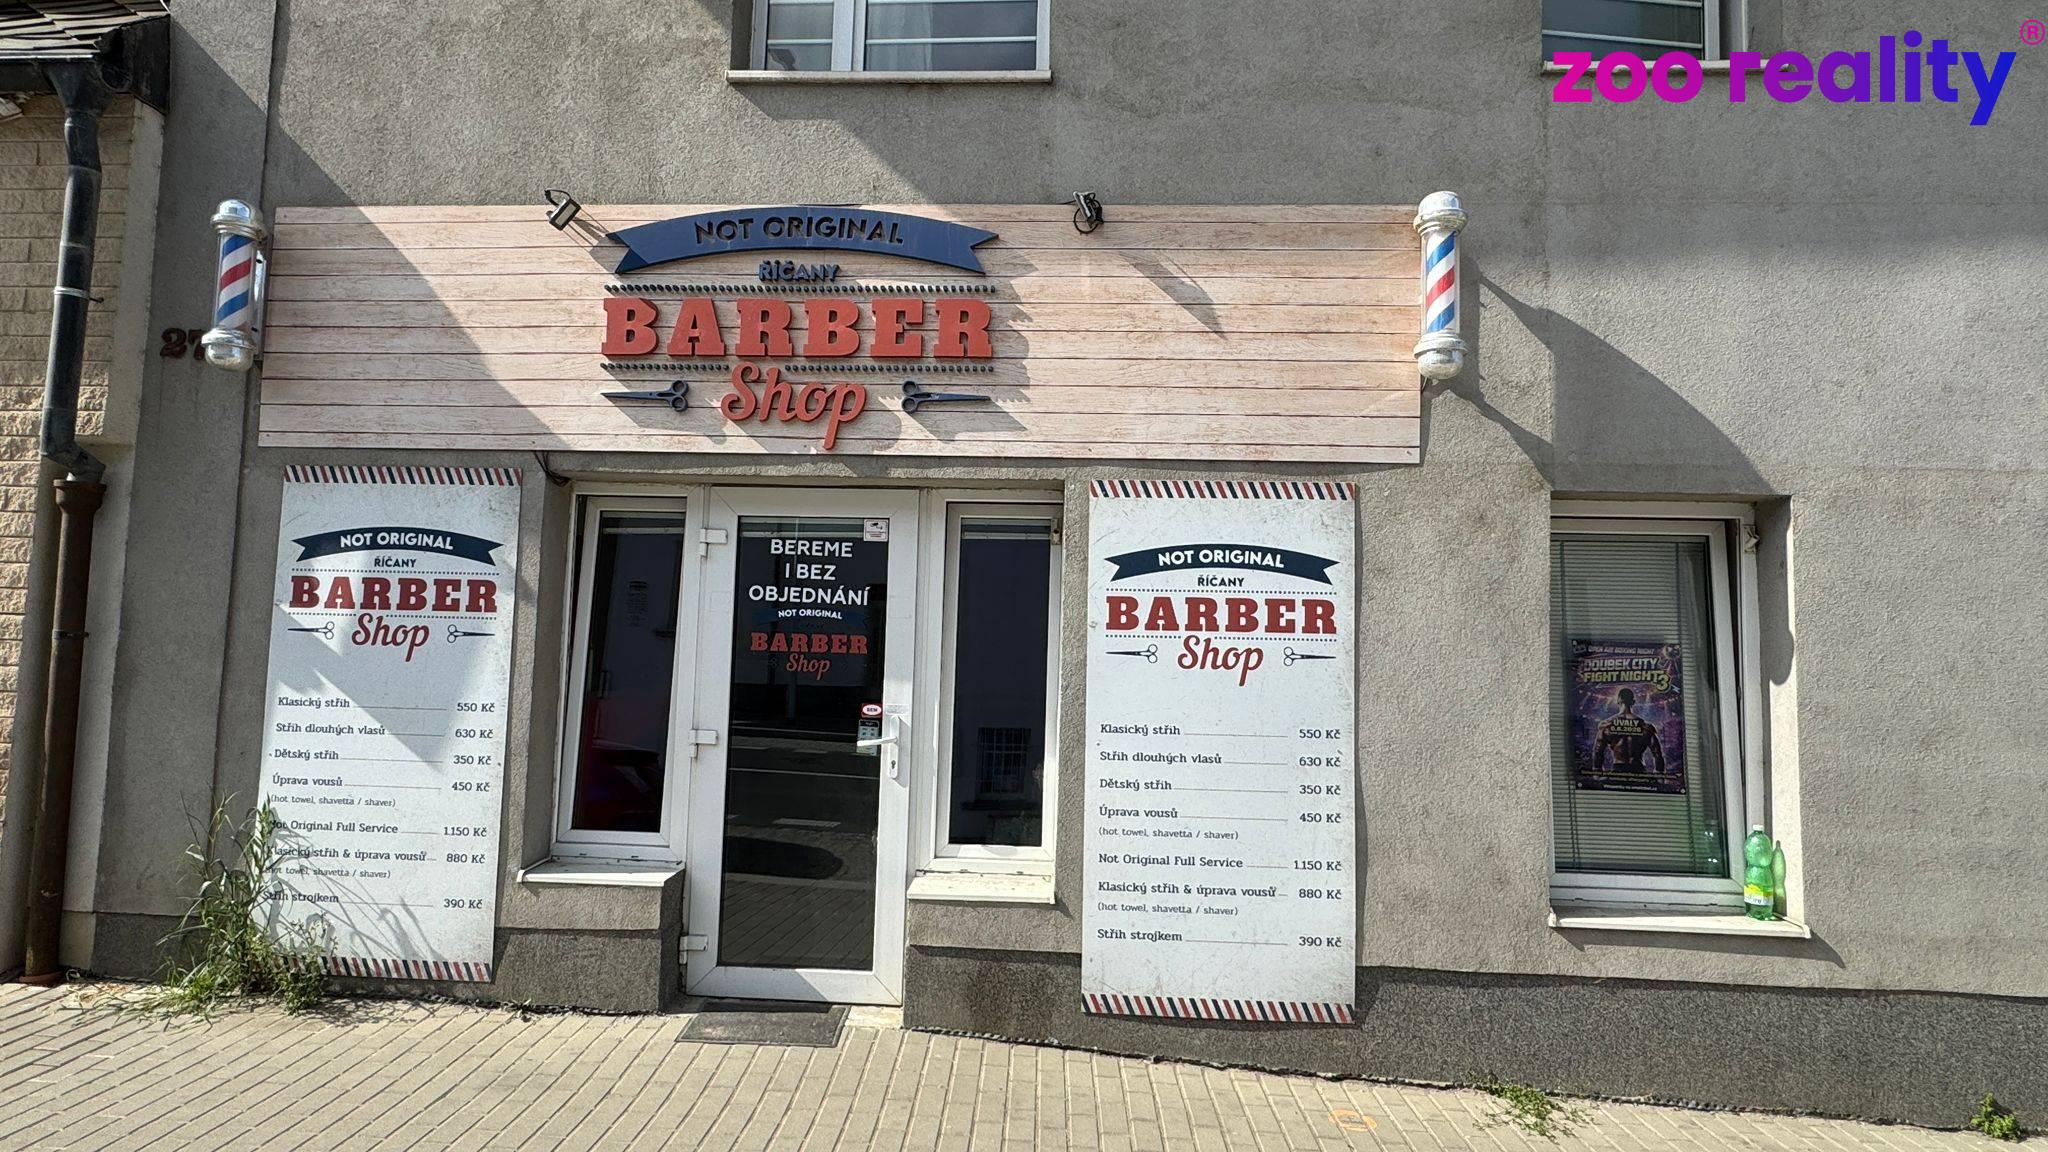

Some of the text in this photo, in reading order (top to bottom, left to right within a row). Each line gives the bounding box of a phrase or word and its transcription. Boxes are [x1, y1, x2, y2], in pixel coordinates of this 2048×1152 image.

[694, 216, 903, 245] NOT ORIGINAL
[758, 259, 840, 282] ŘÍČANY
[601, 297, 993, 358] BARBER
[721, 361, 866, 450] Shop
[340, 532, 454, 550] NOT ORIGINAL
[770, 538, 853, 558] BEREME
[374, 555, 416, 568] ŘÍČANY
[1158, 549, 1285, 568] NOT ORIGINAL
[785, 563, 836, 581] I BEZ
[1197, 574, 1244, 587] ŘÍČANY
[289, 575, 498, 613] BARBER
[749, 585, 871, 606] OBJEDNÁNÍ
[778, 608, 842, 619] NOT ORIGINAL
[1105, 595, 1337, 634] BARBER
[352, 612, 430, 662] Shop
[750, 632, 867, 655] BARBER
[786, 653, 831, 681] Shop
[1178, 634, 1264, 687] Shop
[1584, 671, 1619, 682] FIGHT
[278, 697, 495, 713] Klasický střih 550 Kč
[276, 722, 494, 739] Střih dlouhých vlasů 630 Kč
[1100, 724, 1341, 739] Klasický střih 550 Kč
[274, 748, 492, 765] Dětský střih 350 Kč
[1100, 751, 1341, 767] Střih dlouhých vlasů 630 Kč
[272, 772, 490, 792] Úprava vousů 450 Kč
[1099, 778, 1341, 795] Dětský střih 350 Kč
[318, 796, 354, 805] shavetta
[1099, 804, 1341, 823] Úprava vousů 450 Kč
[290, 820, 333, 831] Original
[336, 821, 355, 831] Full
[359, 822, 398, 833] Service
[473, 827, 487, 837] Kč
[1152, 829, 1192, 838] shavetta
[1204, 830, 1239, 840] shaver)
[314, 848, 339, 858] střih
[343, 849, 351, 858] &
[355, 849, 390, 861] úprava
[395, 851, 427, 861] vousů
[446, 853, 467, 863] 880
[471, 853, 486, 864] Kč
[1099, 854, 1119, 863] Not
[1123, 854, 1170, 866] Original
[1174, 856, 1195, 866] Full
[1199, 857, 1243, 868] Service
[1326, 860, 1342, 871] Kč
[1098, 882, 1342, 899] Klasický střih & úprava vousů 880 Kč
[291, 893, 339, 903] strojkem
[443, 898, 464, 908] 390
[468, 899, 483, 909] Kč
[1152, 904, 1192, 914] shavetta
[1203, 906, 1239, 915] shaver)
[1097, 928, 1342, 947] Střih strojkem 390 Kč
